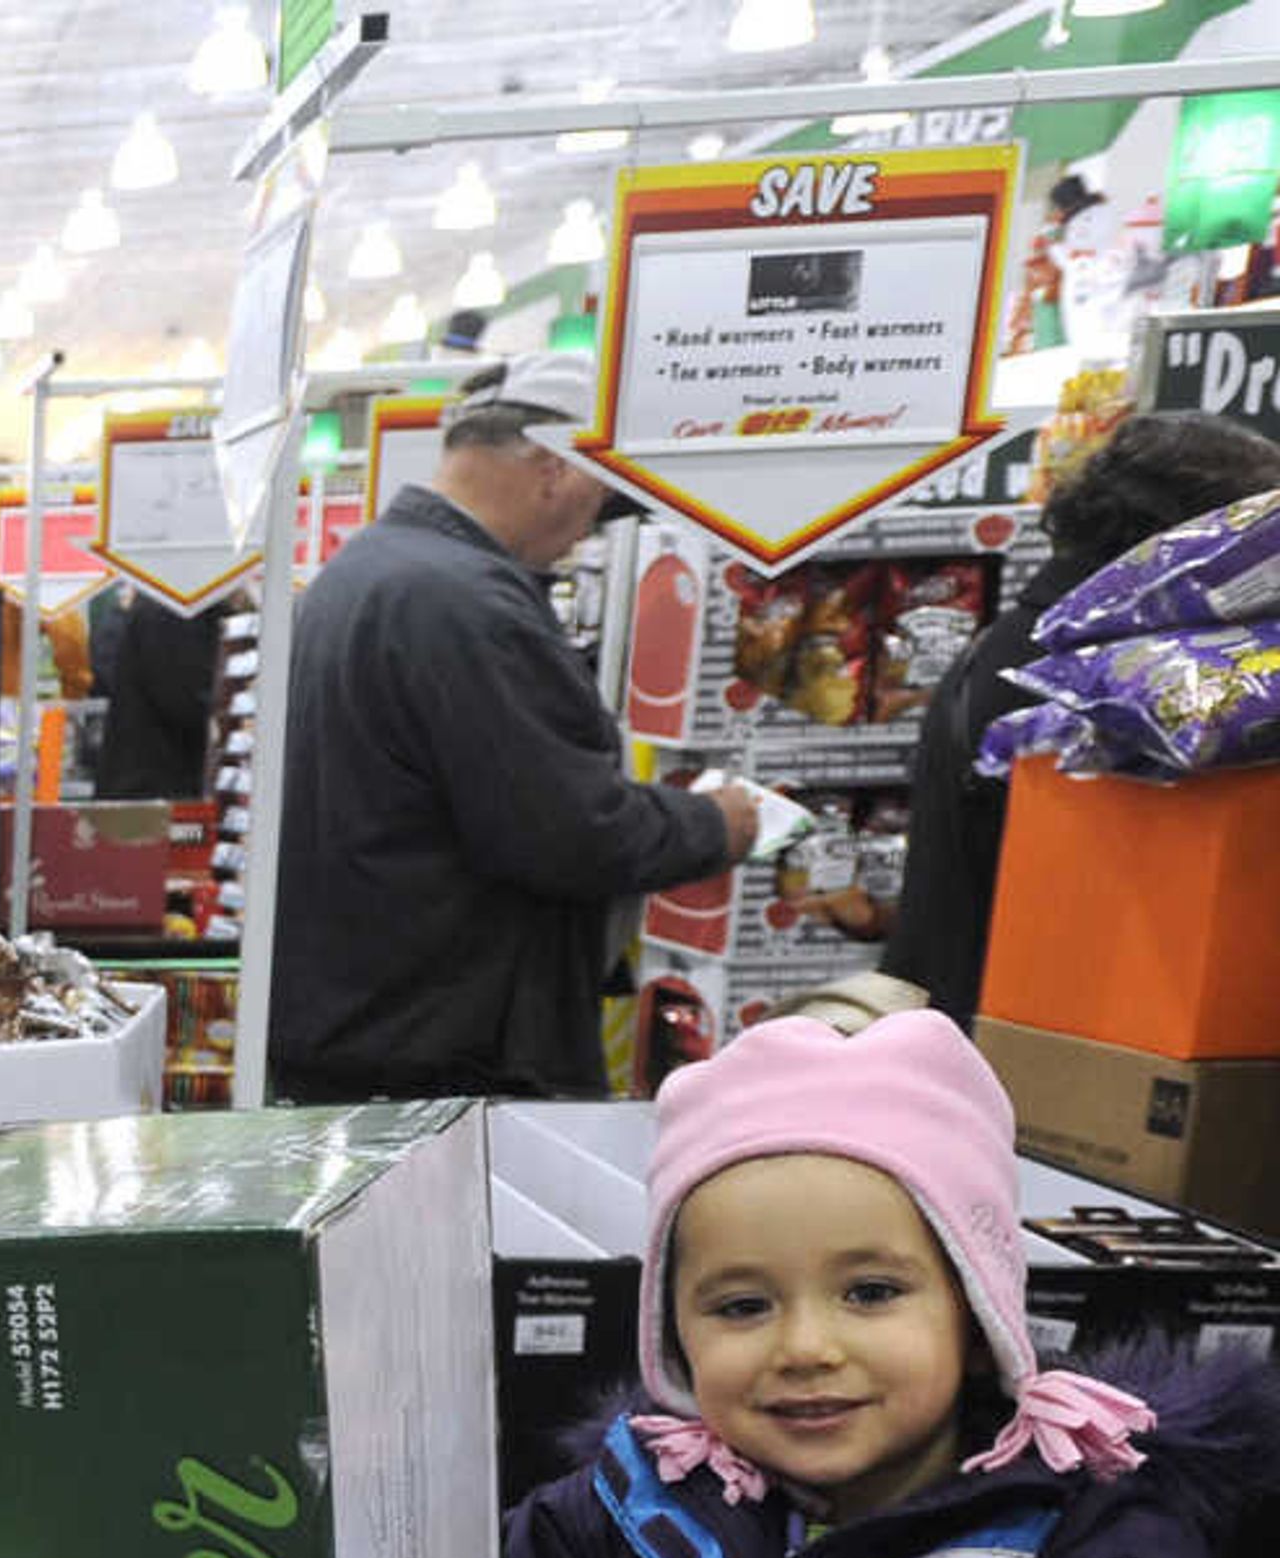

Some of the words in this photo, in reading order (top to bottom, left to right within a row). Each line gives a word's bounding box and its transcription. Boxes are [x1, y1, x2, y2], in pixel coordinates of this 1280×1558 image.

[749, 163, 879, 219] SAVE
[718, 328, 794, 345] warmers
[866, 320, 944, 338] warmers
[706, 363, 781, 381] warmers
[812, 354, 857, 378] Body
[864, 356, 942, 374] warmers
[1168, 330, 1280, 416] "Dr
[6, 1284, 32, 1358] 52054
[36, 1283, 58, 1342] 52P2
[40, 1349, 63, 1410] H172
